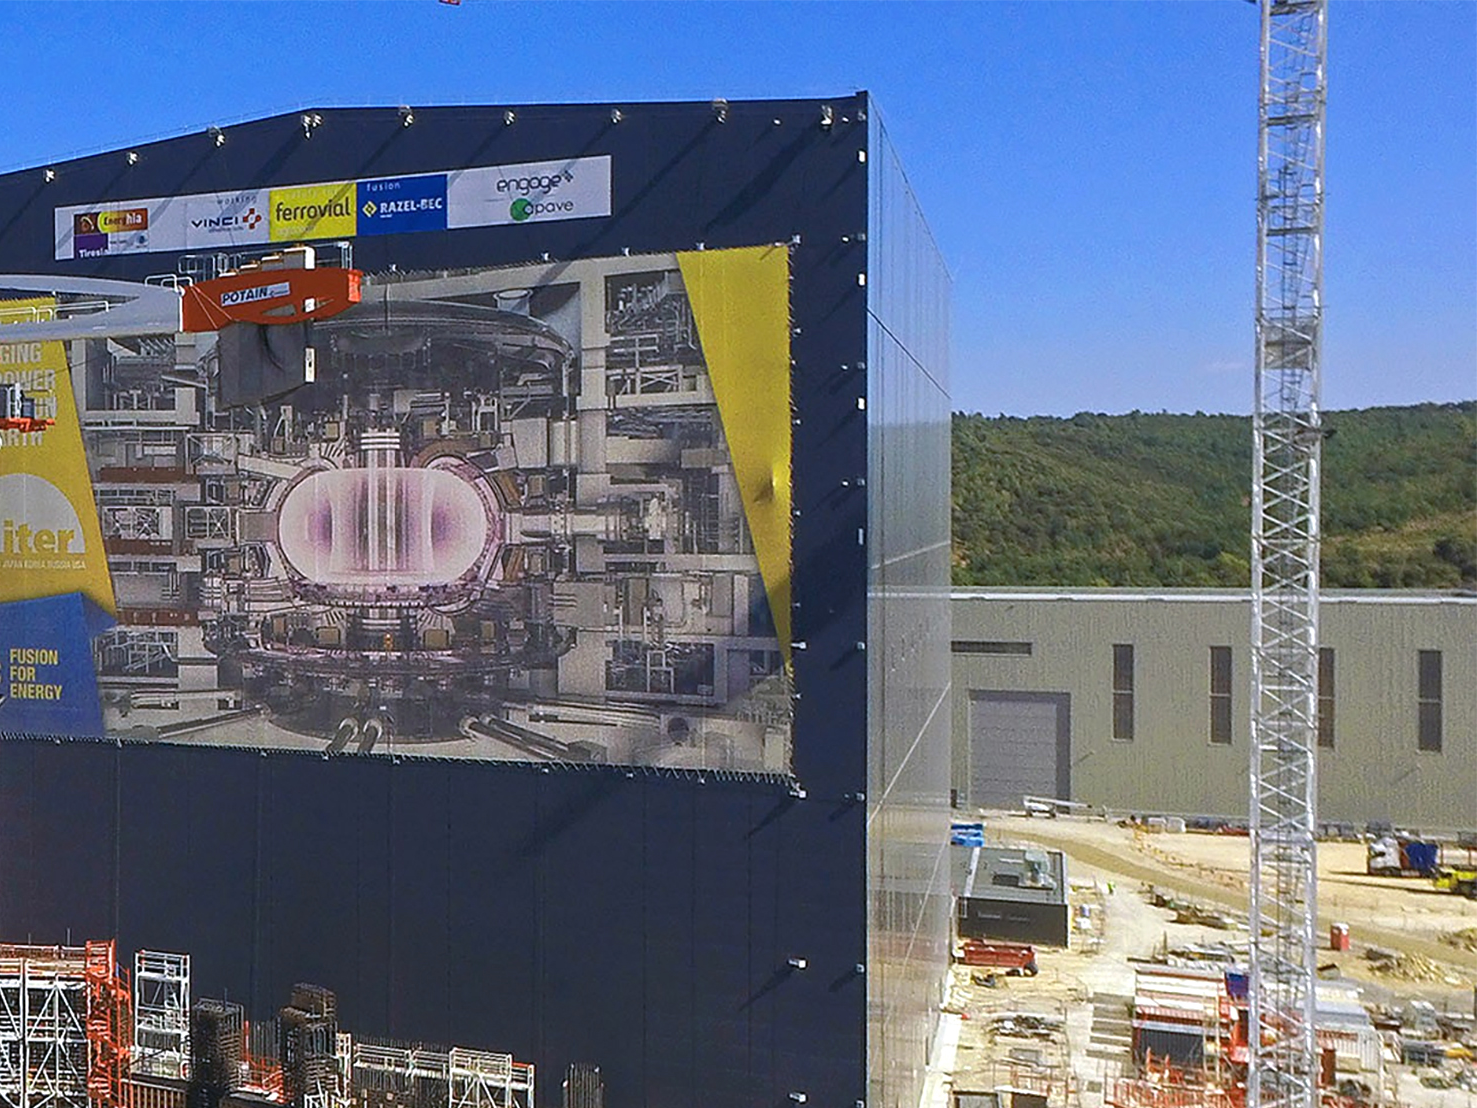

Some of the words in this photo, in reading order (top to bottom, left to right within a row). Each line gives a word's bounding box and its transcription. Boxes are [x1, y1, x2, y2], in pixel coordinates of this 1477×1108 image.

[497, 174, 562, 196] engage
[276, 197, 351, 222] ferrovial
[380, 198, 442, 213] RAZEL-BEC
[522, 201, 574, 215] apave
[191, 216, 239, 229] VINCI
[222, 287, 269, 304] POTAIN
[4, 519, 75, 554] iter
[9, 648, 58, 665] FUSION
[9, 666, 36, 681] FOR
[9, 683, 62, 700] ENERGY
